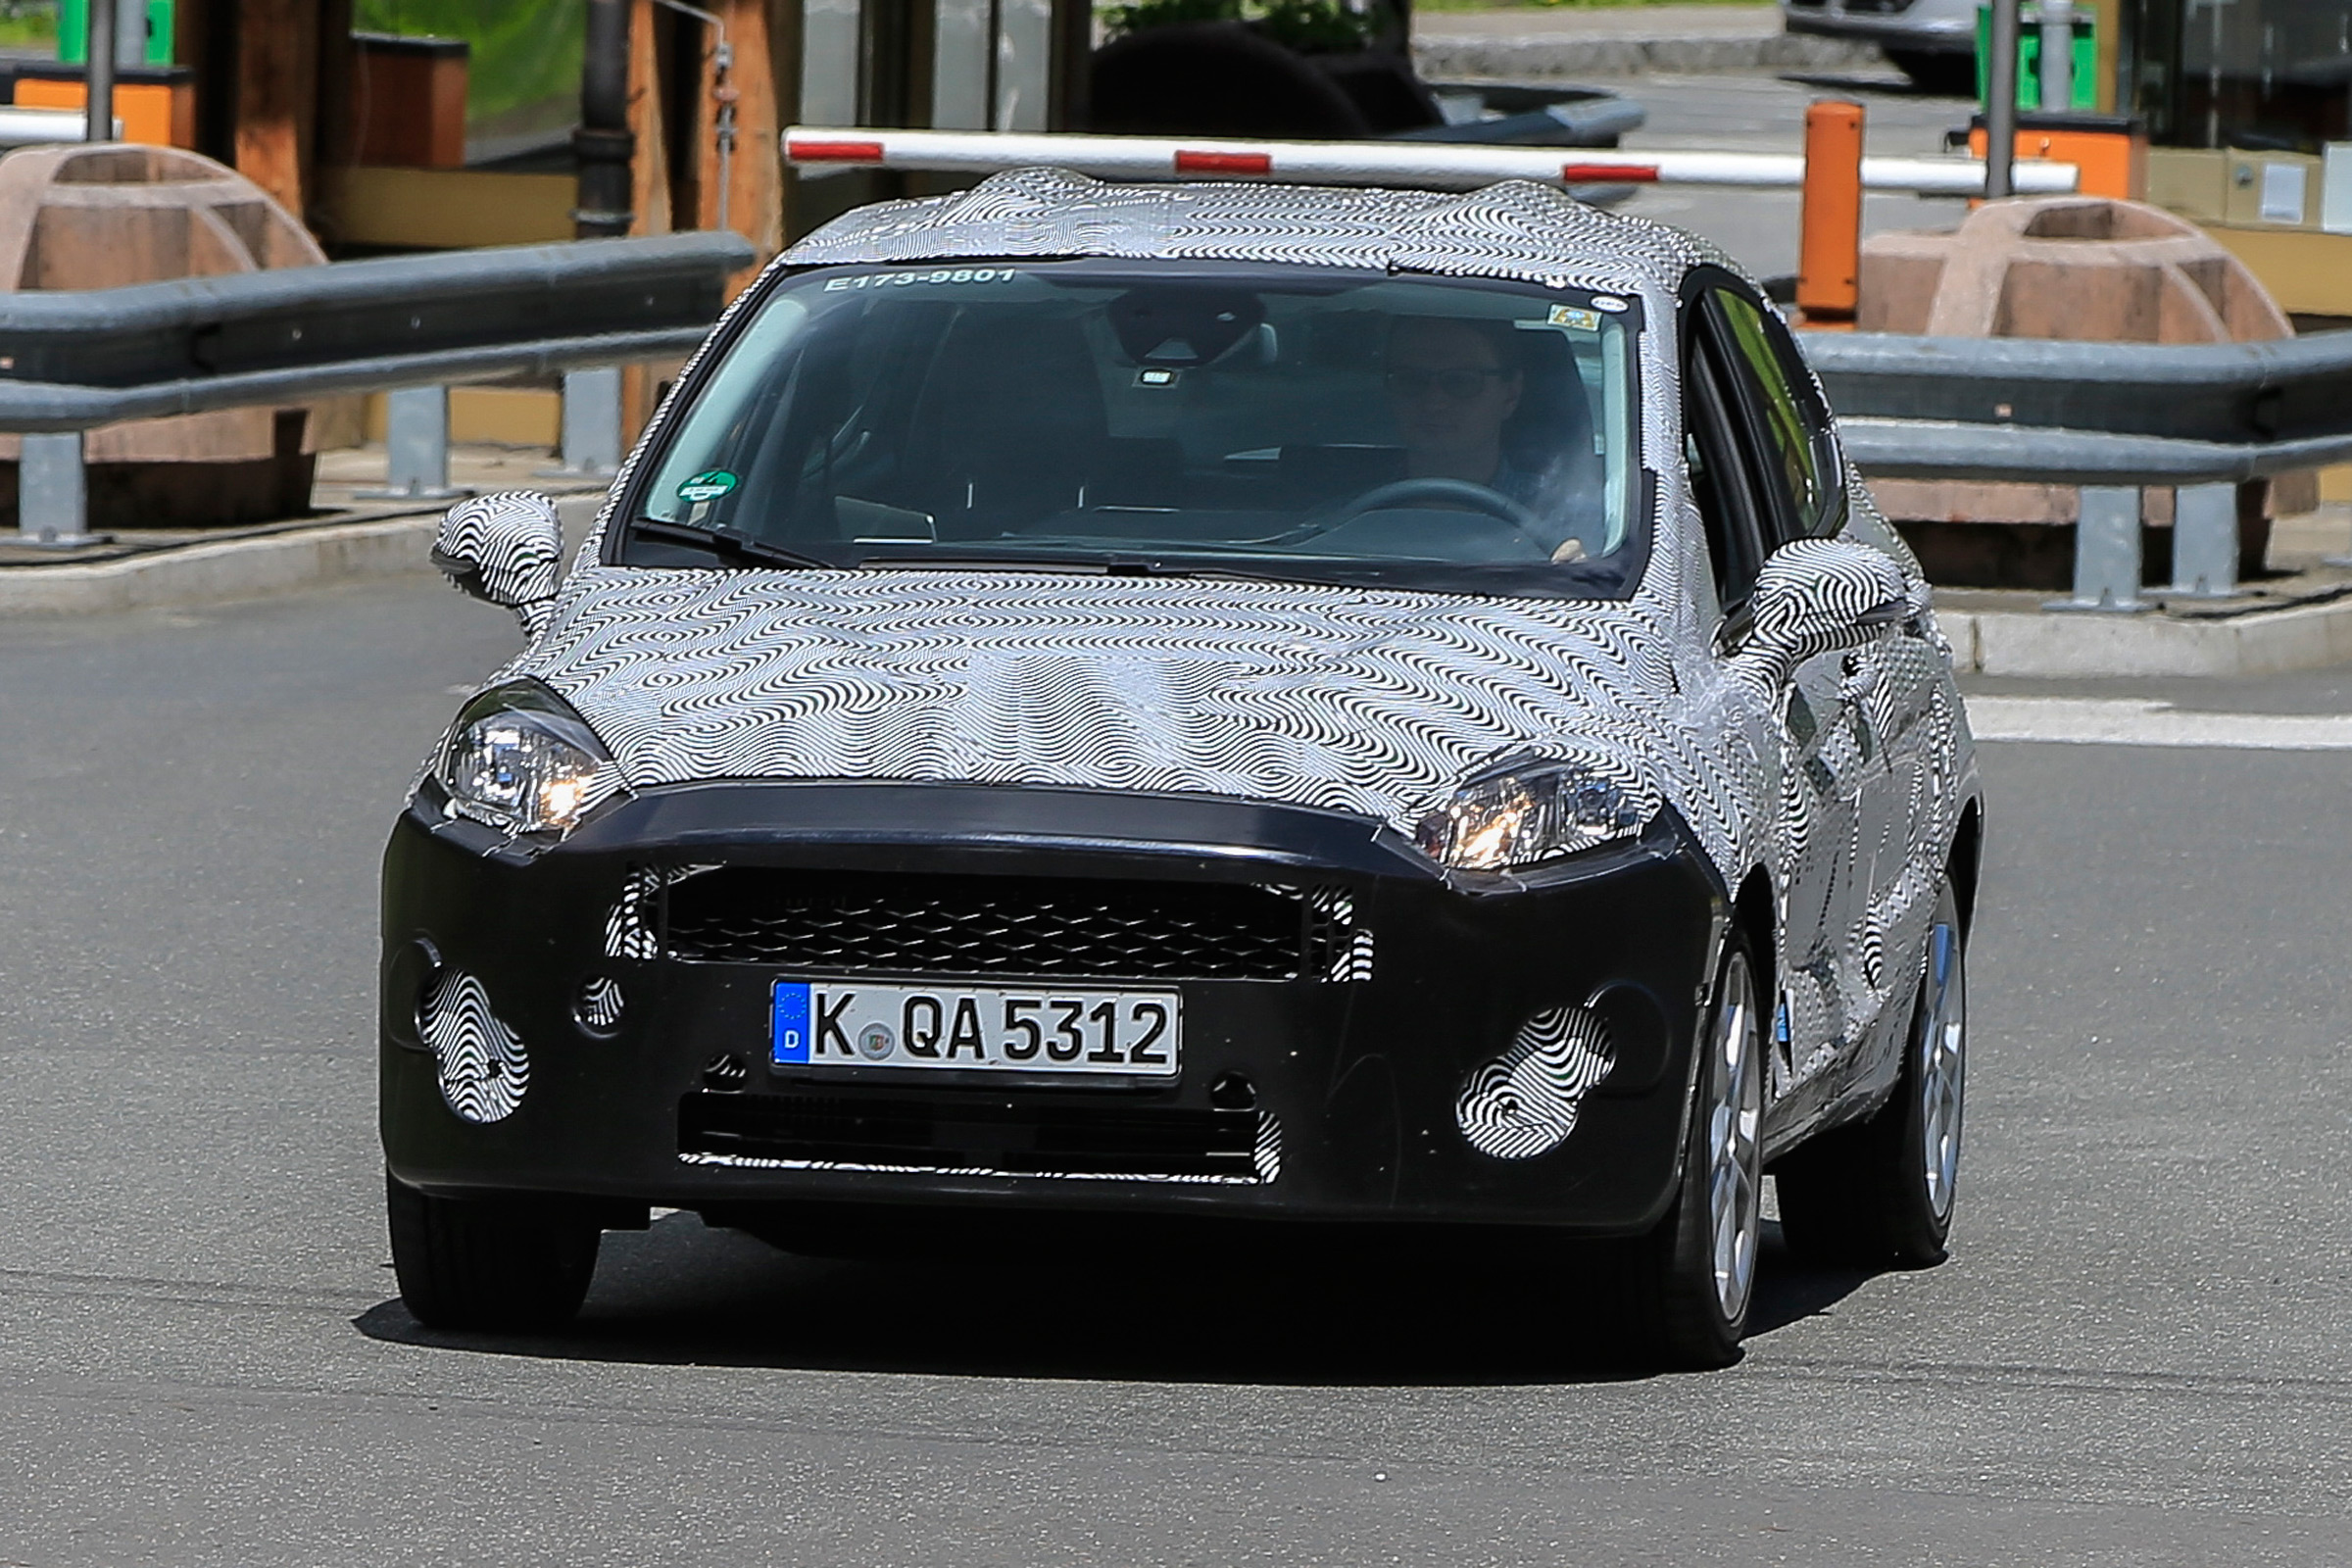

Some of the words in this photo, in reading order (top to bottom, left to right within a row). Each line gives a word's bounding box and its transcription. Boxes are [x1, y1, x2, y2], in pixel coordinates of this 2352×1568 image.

[823, 268, 1016, 292] E173-9801
[784, 1030, 799, 1049] D
[814, 993, 856, 1055] K
[902, 995, 986, 1060] QA
[1002, 1000, 1168, 1063] 5312
